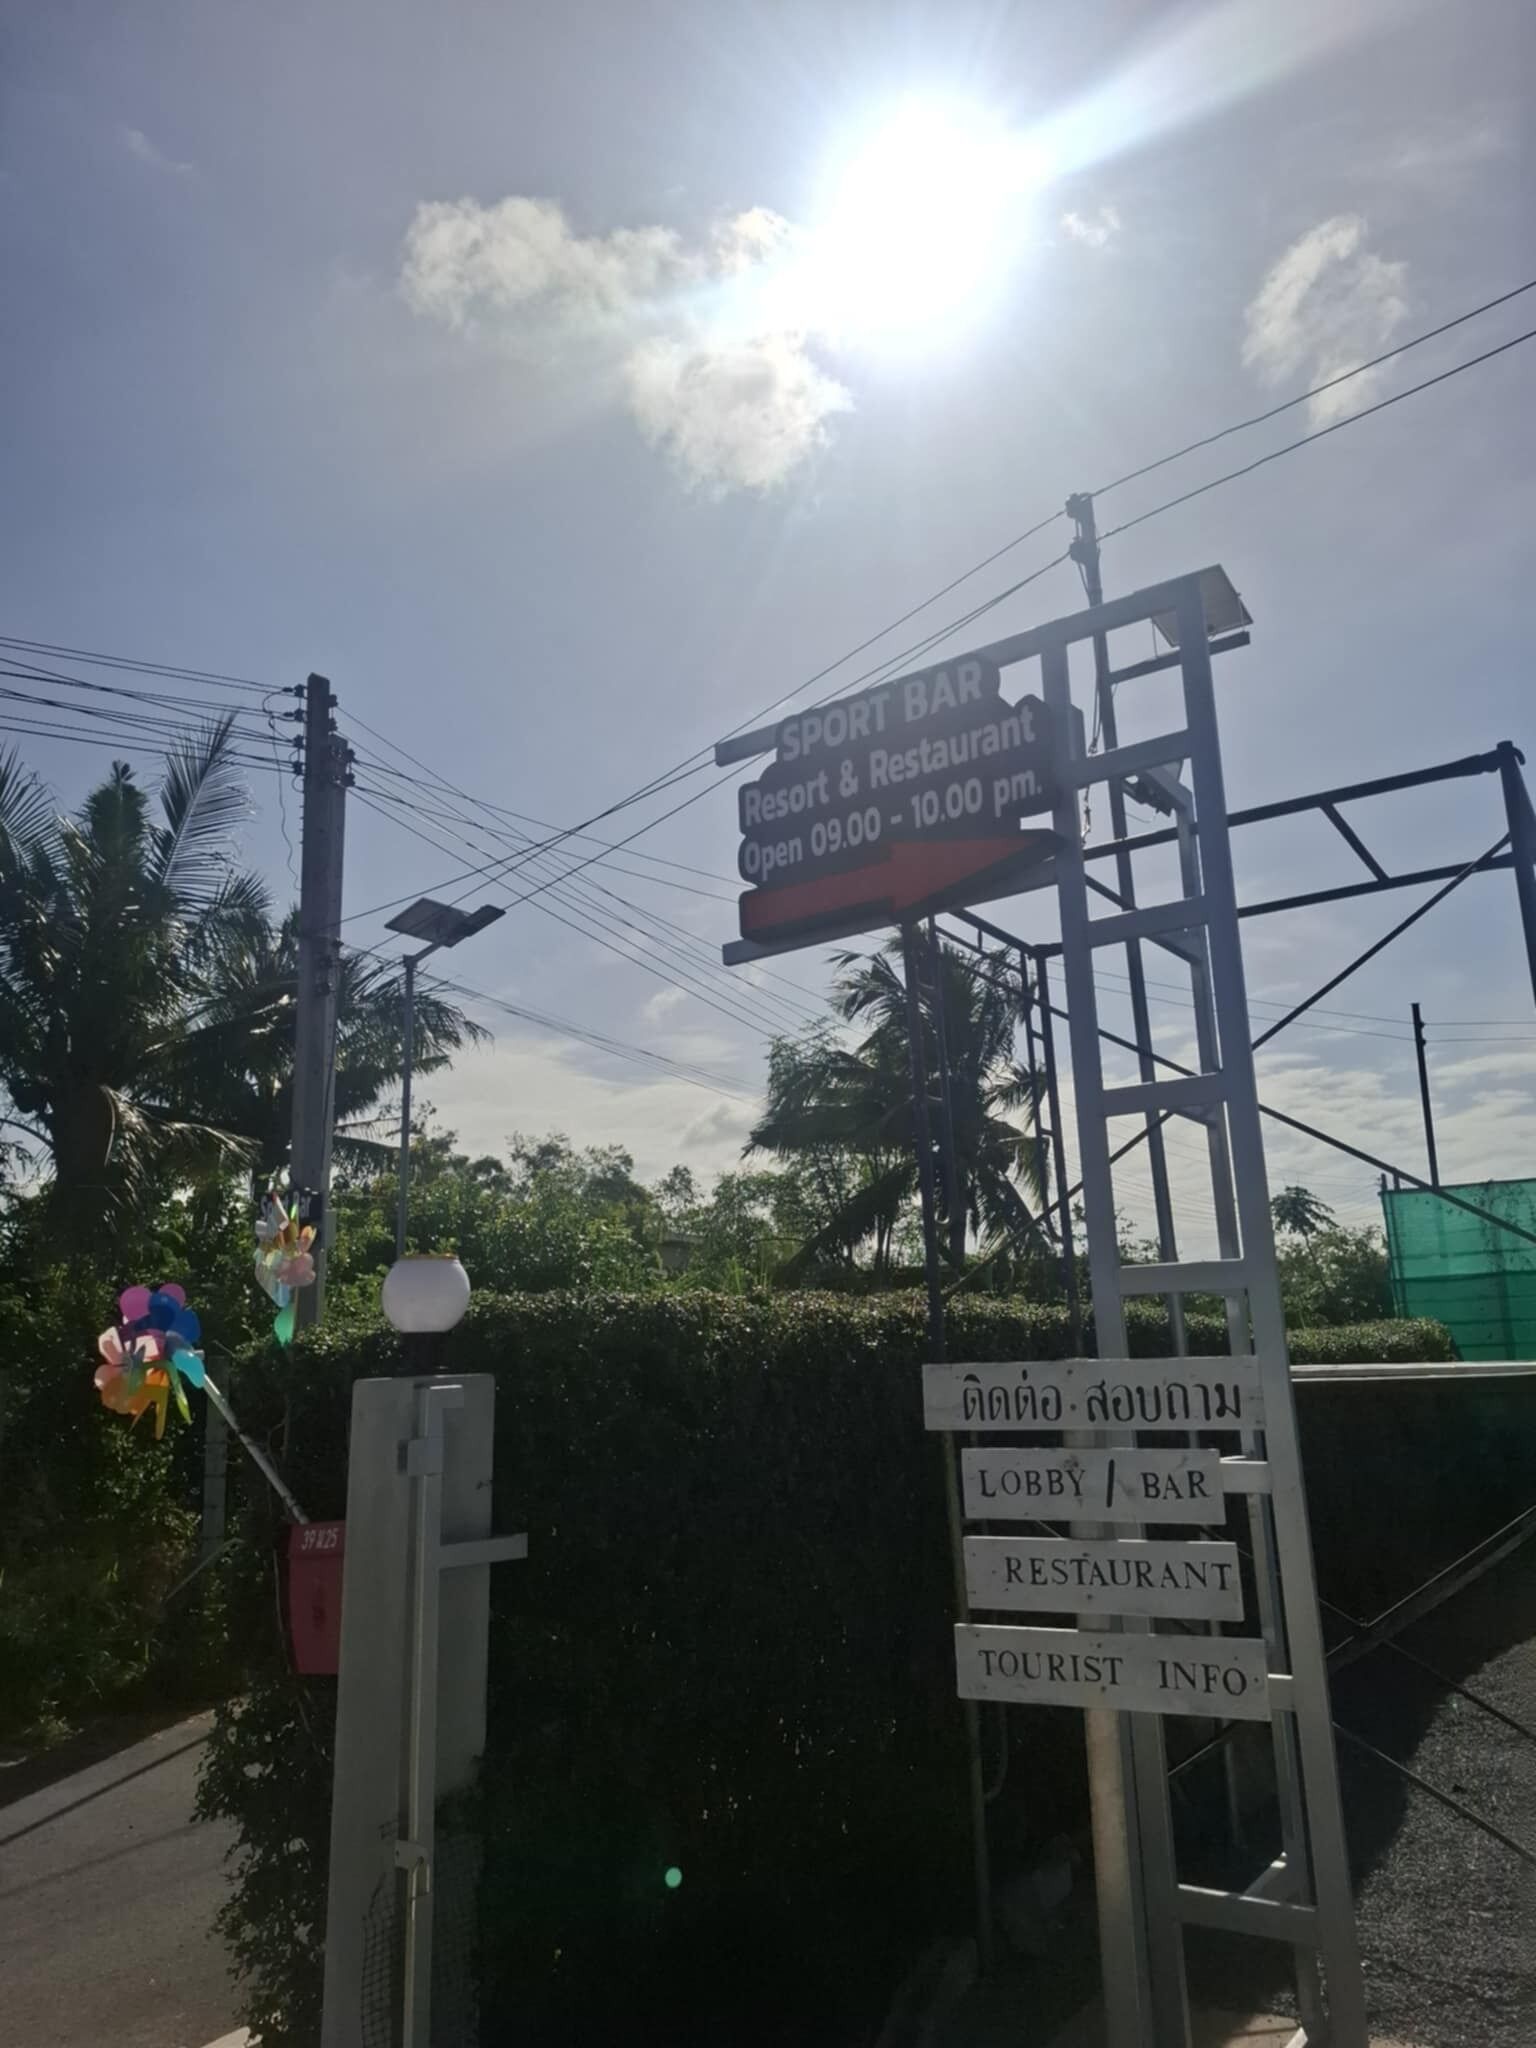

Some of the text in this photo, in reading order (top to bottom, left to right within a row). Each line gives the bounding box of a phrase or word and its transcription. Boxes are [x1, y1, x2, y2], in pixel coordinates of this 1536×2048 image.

[782, 660, 983, 761] SPORT BAR
[745, 704, 1036, 827] Resort & Restaurant
[743, 837, 803, 881] Open
[811, 806, 881, 857] 09.00
[911, 777, 983, 829] 10.00
[994, 769, 1043, 818] pm.
[962, 1369, 1062, 1421] ติดต่อ
[978, 1468, 1086, 1498] LOBBY
[1140, 1470, 1210, 1500] BAR
[1004, 1556, 1232, 1590] RESTAURANT
[978, 1650, 1247, 1696] TOURIST INFO
